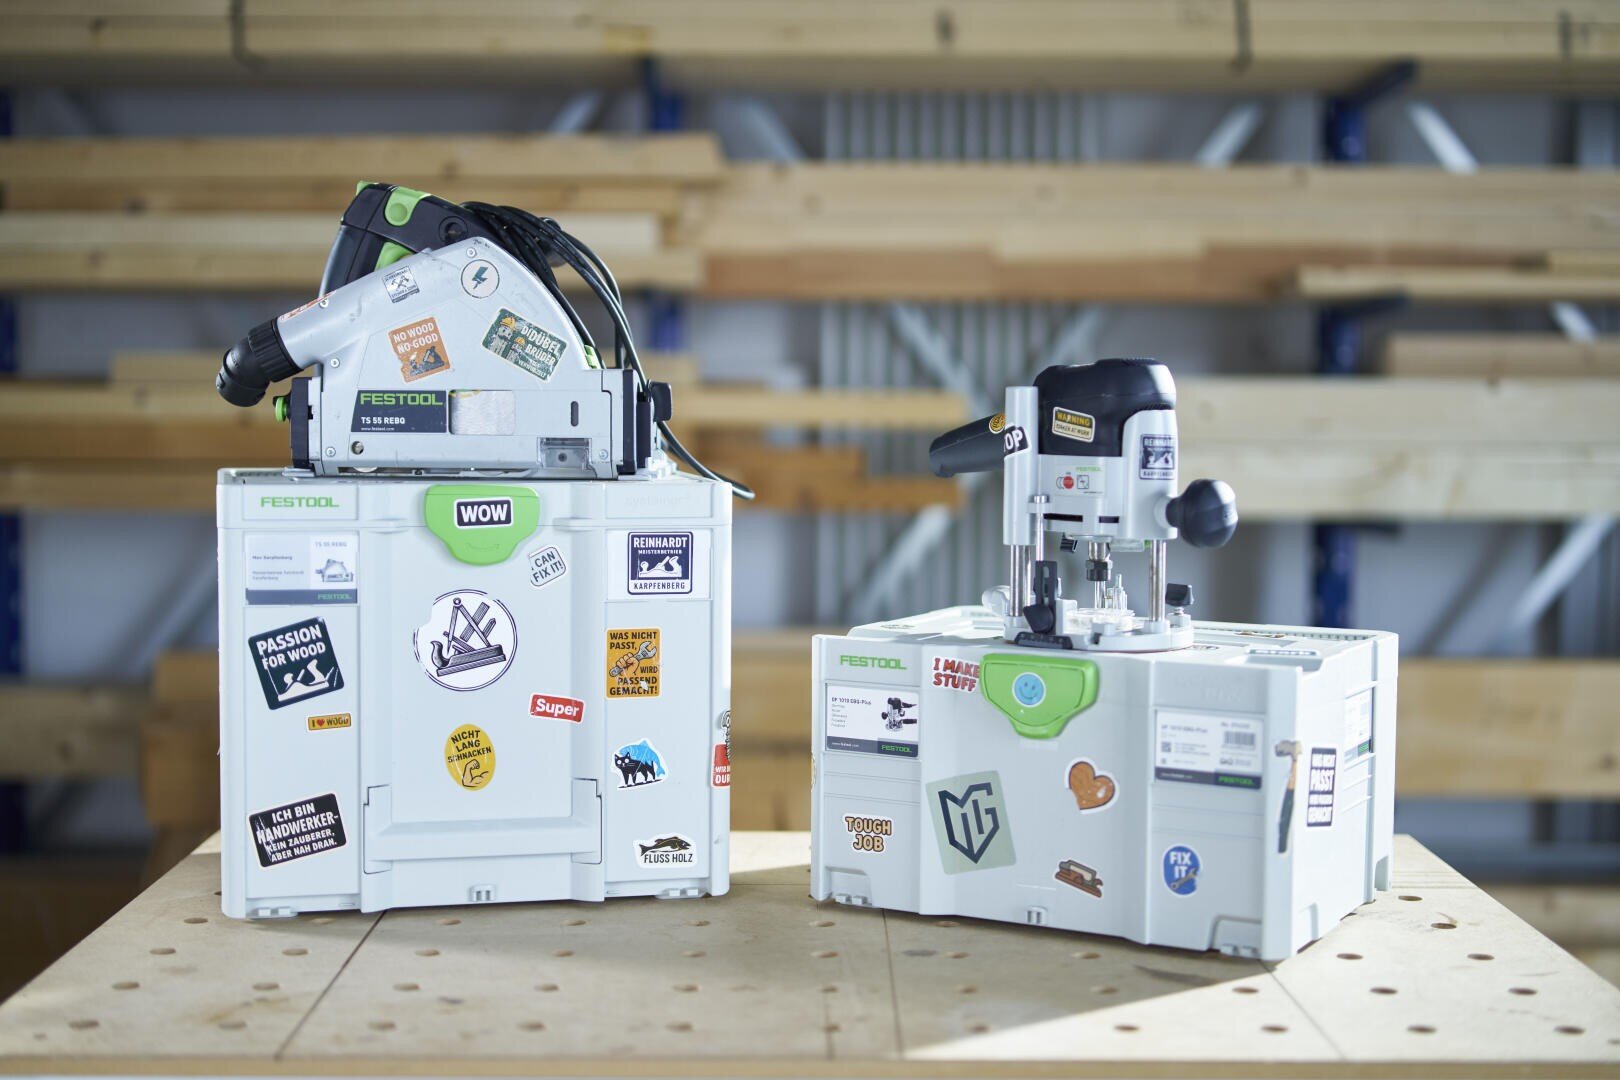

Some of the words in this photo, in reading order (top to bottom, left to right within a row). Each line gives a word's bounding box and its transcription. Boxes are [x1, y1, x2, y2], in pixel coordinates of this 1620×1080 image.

[393, 332, 407, 344] NO
[407, 322, 435, 338] WOOD
[360, 393, 443, 405] FESTOOL
[361, 416, 371, 424] TS
[372, 416, 382, 424] 55
[1056, 411, 1091, 426] WARNING
[260, 496, 340, 508] FESTOOL
[460, 503, 508, 522] WOW
[633, 537, 688, 548] REINHARDT
[534, 551, 556, 568] CAN
[532, 566, 551, 583] FIX
[550, 560, 564, 575] IT!
[633, 582, 685, 590] KARPFENBERG
[256, 624, 323, 656] PASSION
[609, 632, 629, 640] WAS
[631, 631, 657, 640] NICHT
[609, 641, 637, 650] PASST,
[261, 653, 287, 670] FOR
[286, 641, 326, 662] WOOD
[840, 655, 907, 670] FESTOOL
[933, 657, 941, 670] I
[943, 659, 980, 678] MAKE
[933, 672, 977, 691] STUFF
[536, 699, 579, 716] Super
[451, 730, 480, 744] NICHT
[456, 740, 480, 752] LANG
[881, 744, 912, 753] FESTOOL
[271, 808, 293, 823] ICH
[294, 803, 315, 817] BIN
[845, 816, 892, 836] TOUGH
[265, 841, 287, 852] KEIN
[288, 828, 335, 847] ZAUBERER,
[853, 833, 884, 852] JOB
[271, 849, 293, 862] ABER
[294, 844, 311, 856] NAH
[312, 838, 337, 851] DRAN.
[644, 853, 670, 863] FLUSS
[672, 853, 693, 863] HOLZ
[1170, 851, 1192, 865] FIX
[1174, 866, 1188, 878] IT
